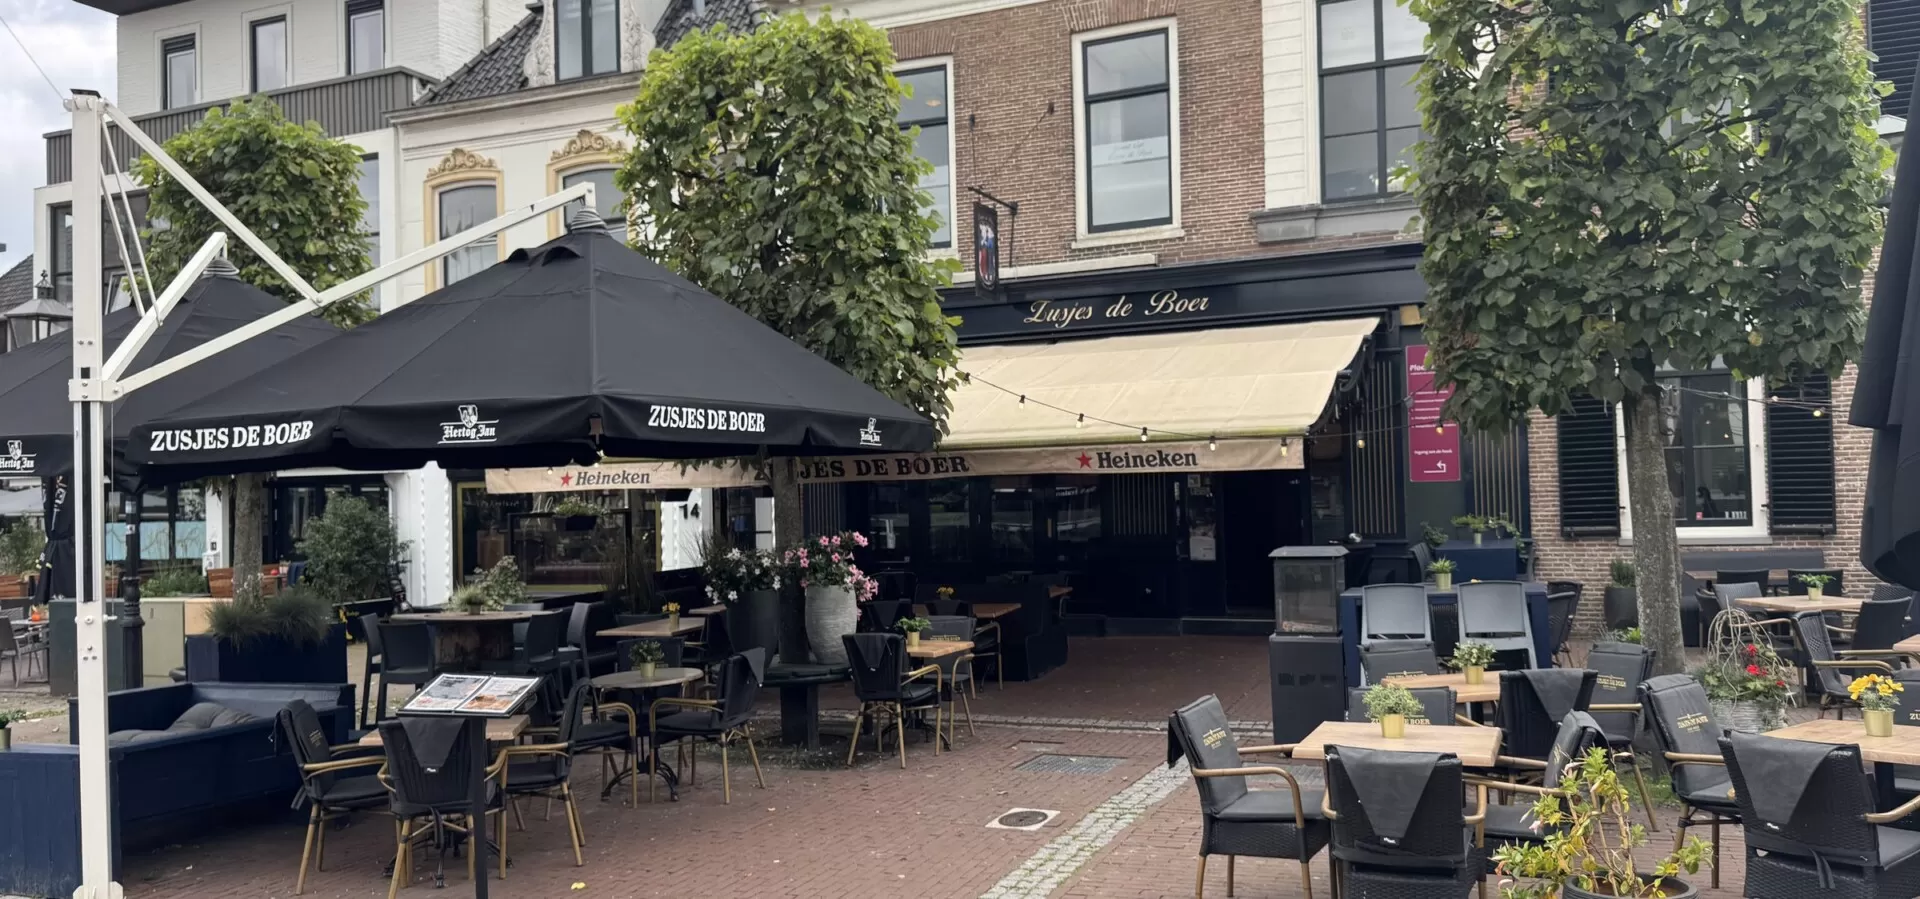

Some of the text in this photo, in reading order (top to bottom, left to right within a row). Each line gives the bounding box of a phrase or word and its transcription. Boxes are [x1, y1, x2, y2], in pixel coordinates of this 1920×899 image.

[1023, 288, 1209, 328] Zusjes de Boer
[648, 404, 766, 433] ZUSJES DE BOER
[150, 420, 314, 452] ZUSJES DE BOER
[442, 424, 496, 441] Hertog Jan
[854, 459, 889, 476] DE
[895, 456, 970, 475] BOER
[1096, 450, 1199, 469] Heineken
[575, 470, 651, 486] Heineken
[679, 503, 700, 520] 14
